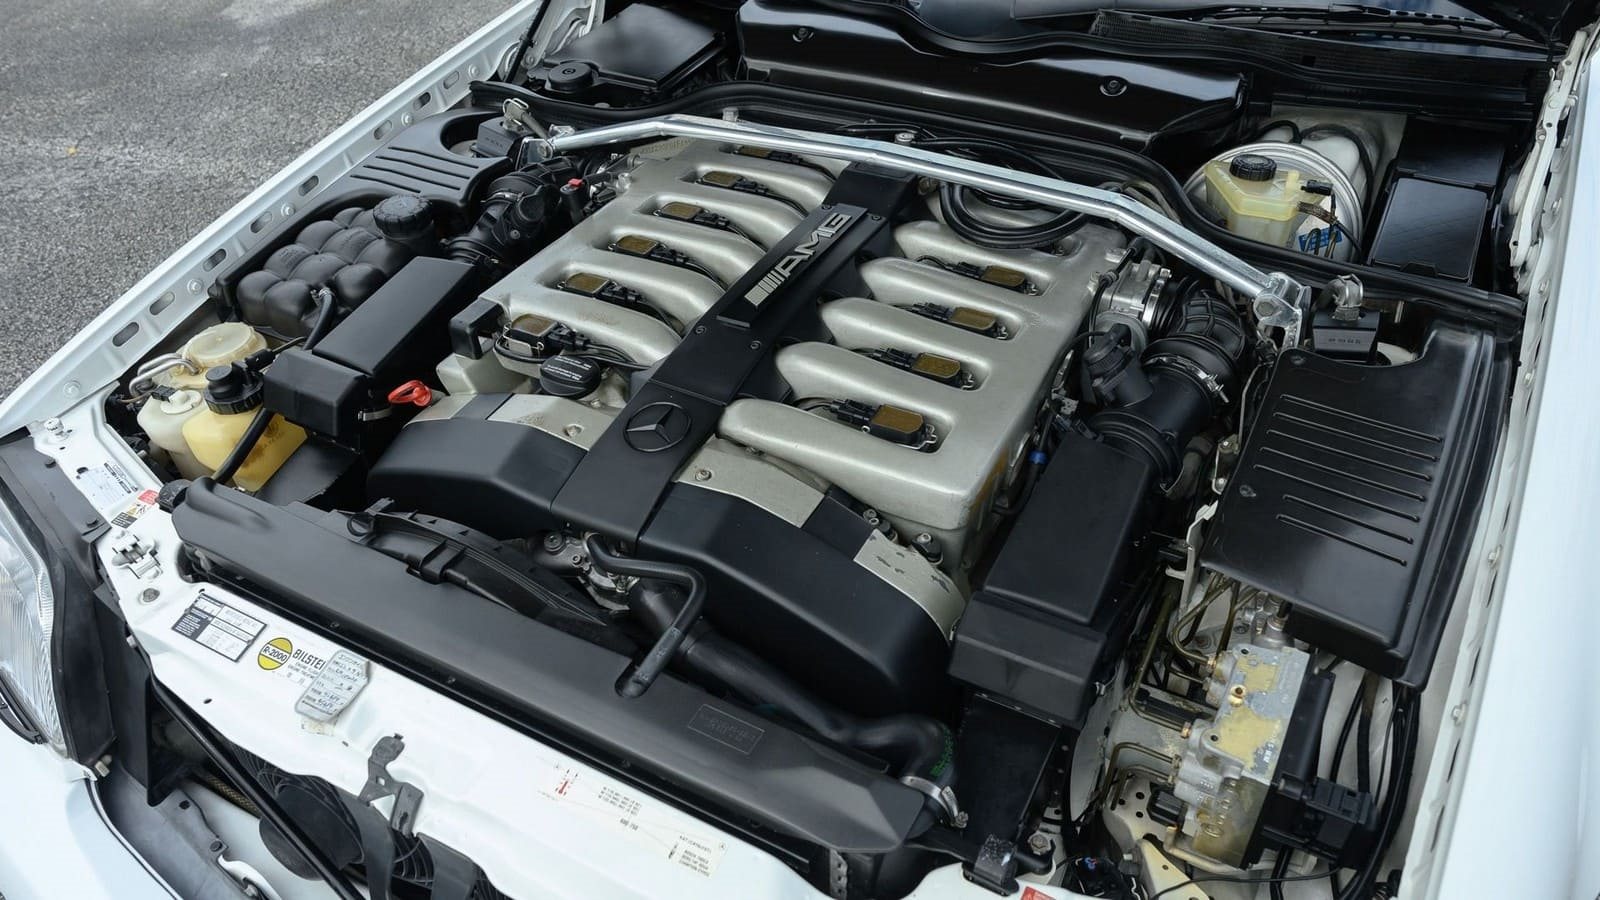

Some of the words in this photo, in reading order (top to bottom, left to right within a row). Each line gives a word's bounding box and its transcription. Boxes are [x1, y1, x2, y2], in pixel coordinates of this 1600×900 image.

[774, 212, 852, 279] AMG
[263, 646, 288, 662] R-2000
[292, 649, 326, 670] BILSTEI
